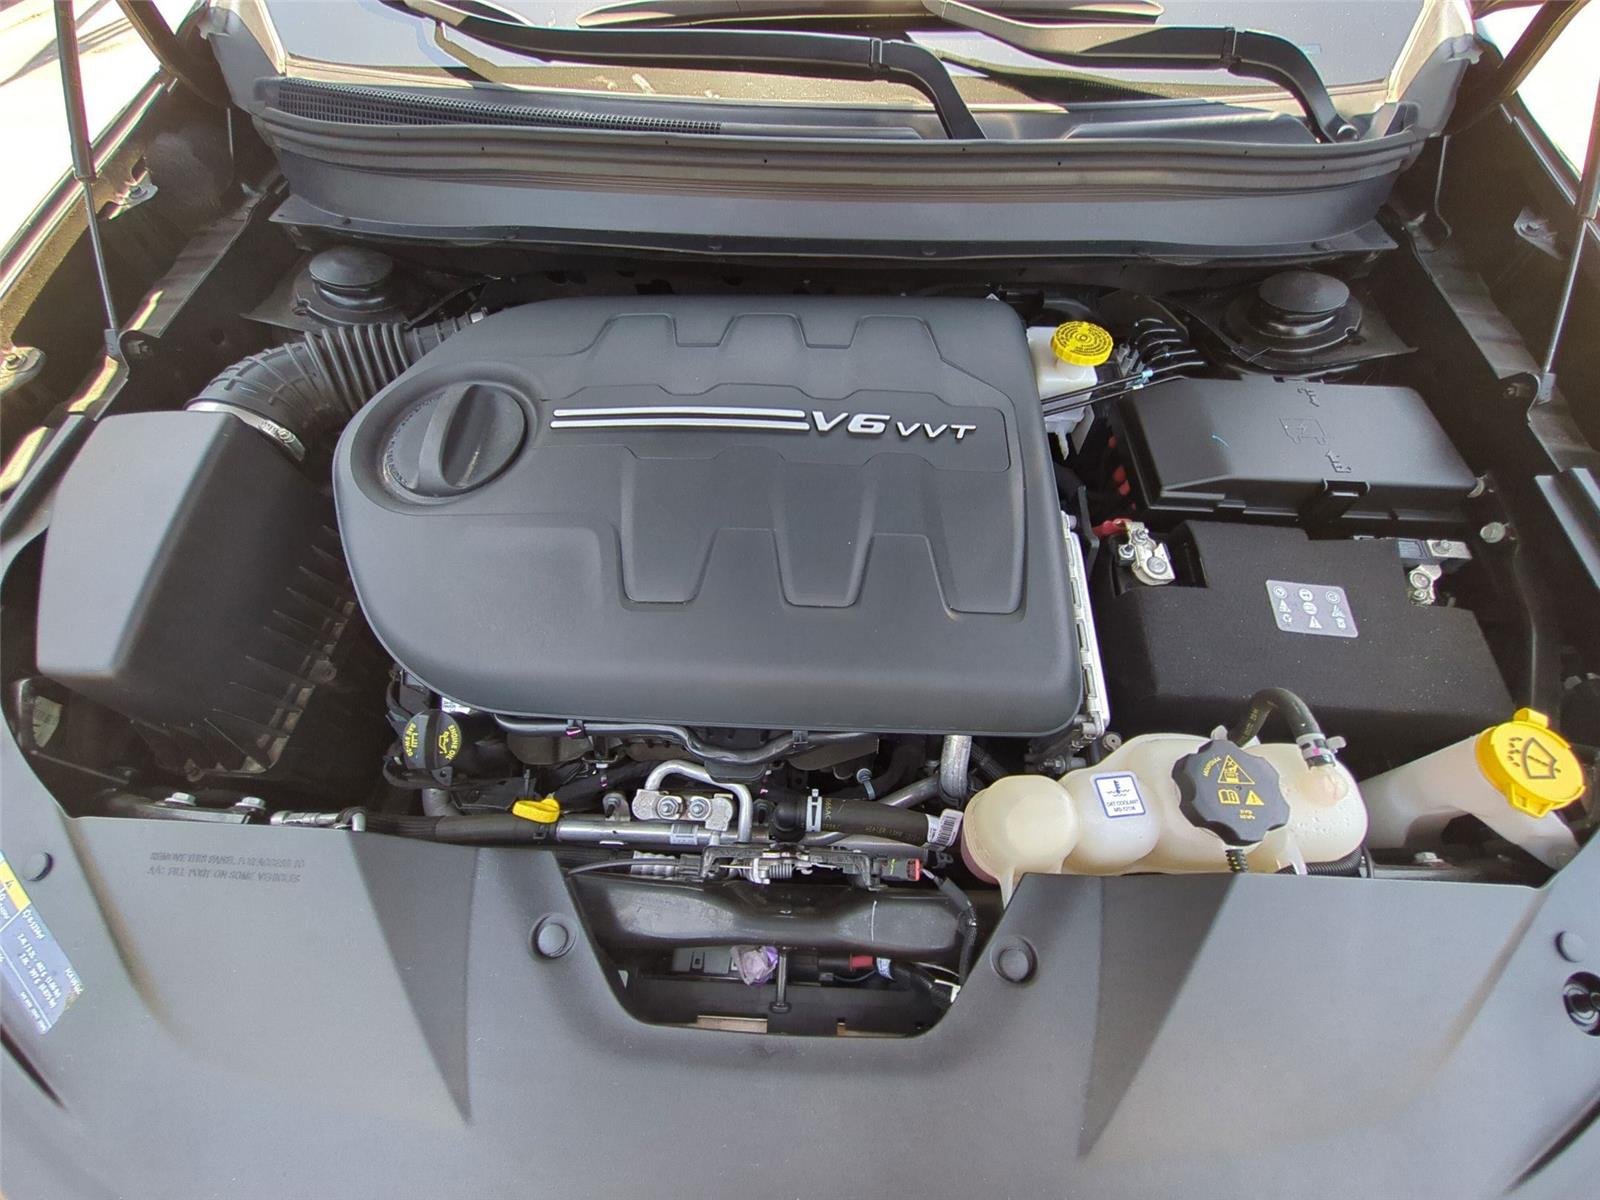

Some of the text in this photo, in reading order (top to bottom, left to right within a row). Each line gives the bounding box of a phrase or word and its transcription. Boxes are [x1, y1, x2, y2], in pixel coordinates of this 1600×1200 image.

[812, 410, 977, 440] V6 VVT
[447, 724, 459, 749] ENGINE
[445, 750, 456, 760] OIL
